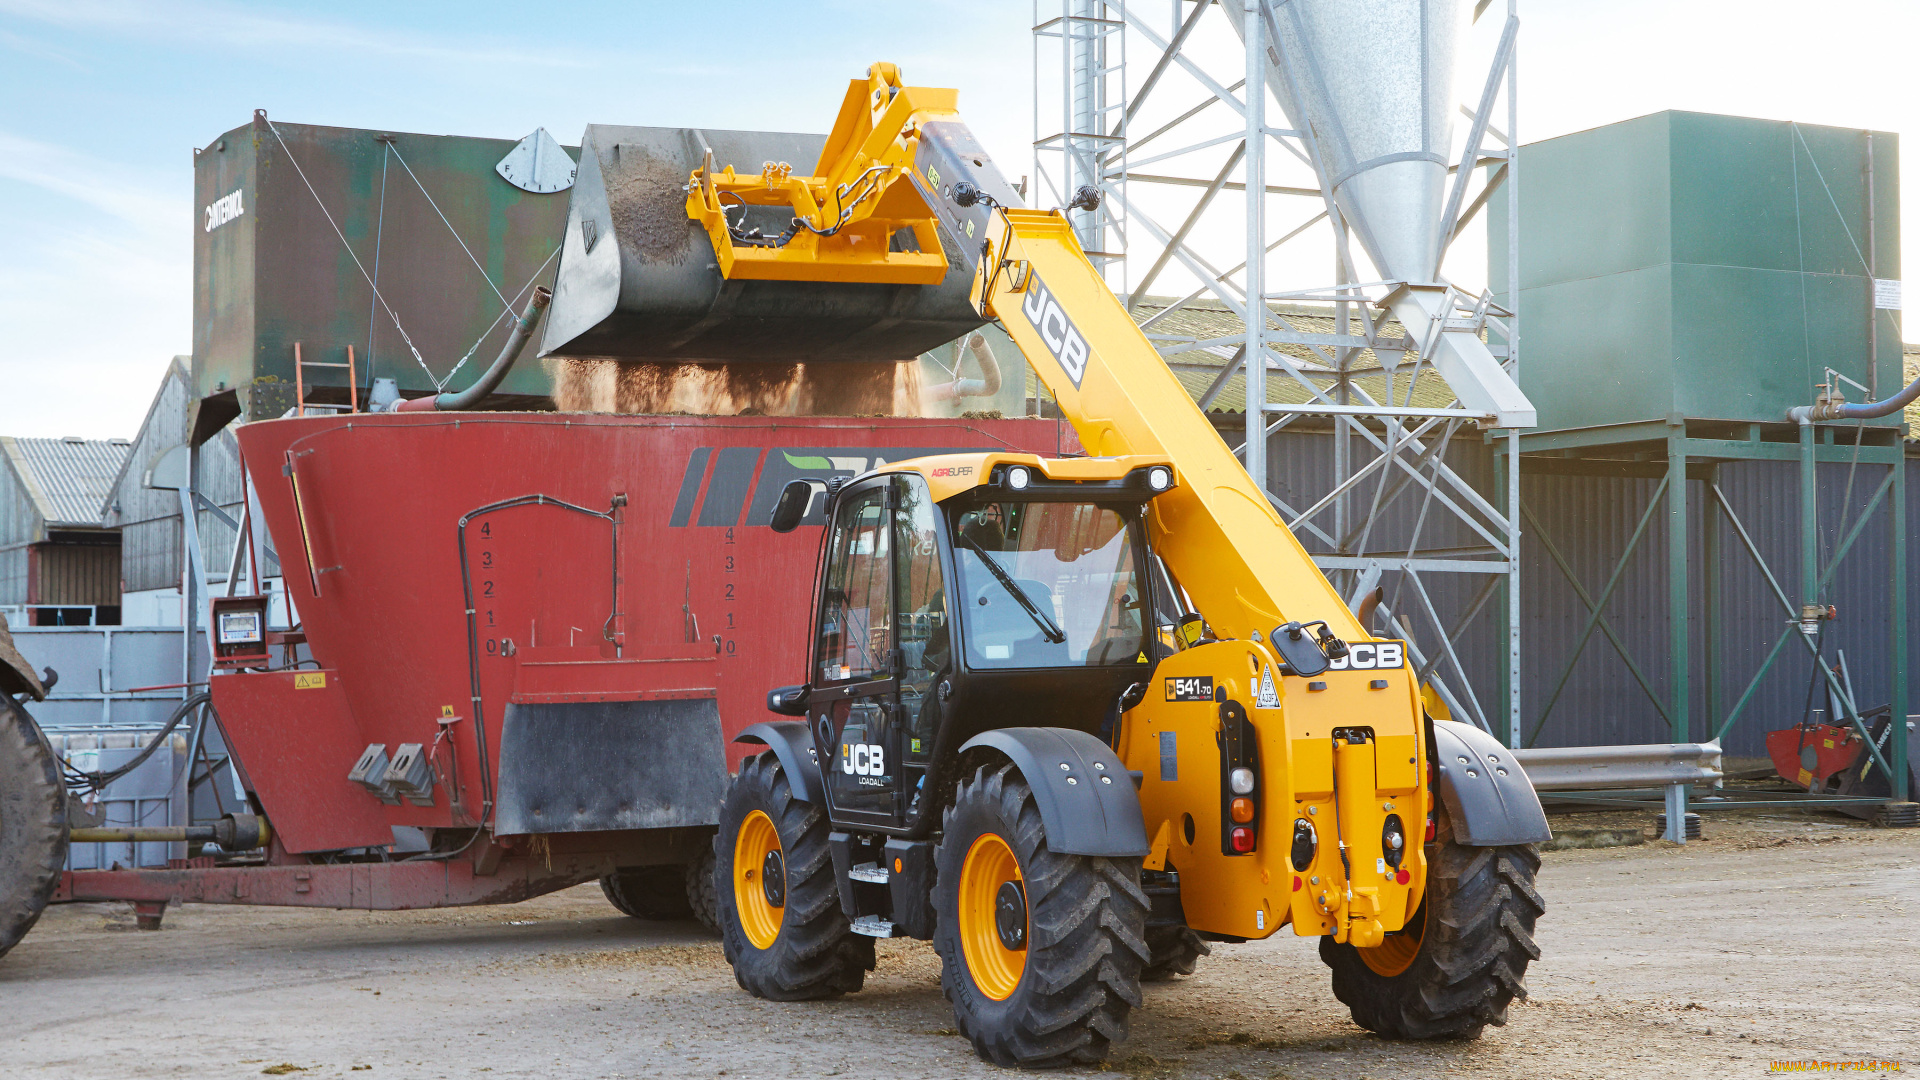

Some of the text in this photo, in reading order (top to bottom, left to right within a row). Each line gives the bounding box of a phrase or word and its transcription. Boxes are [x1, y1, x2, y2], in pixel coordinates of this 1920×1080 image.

[504, 164, 511, 172] F
[570, 170, 576, 178] E
[211, 188, 244, 230] INTERMOL
[1025, 287, 1087, 383] JCB
[931, 466, 973, 477] AGRISUPER
[481, 522, 491, 536] 4
[725, 527, 735, 541] 4
[482, 551, 492, 566] 3
[725, 556, 735, 570] 3
[483, 581, 494, 595] 2
[725, 583, 735, 598] 2
[486, 609, 494, 624] 1
[726, 612, 734, 626] 1
[486, 639, 497, 653] 0
[725, 640, 736, 654] 0
[1330, 643, 1403, 670] JCB
[843, 744, 885, 777] JCB
[858, 776, 885, 787] LOADALL
